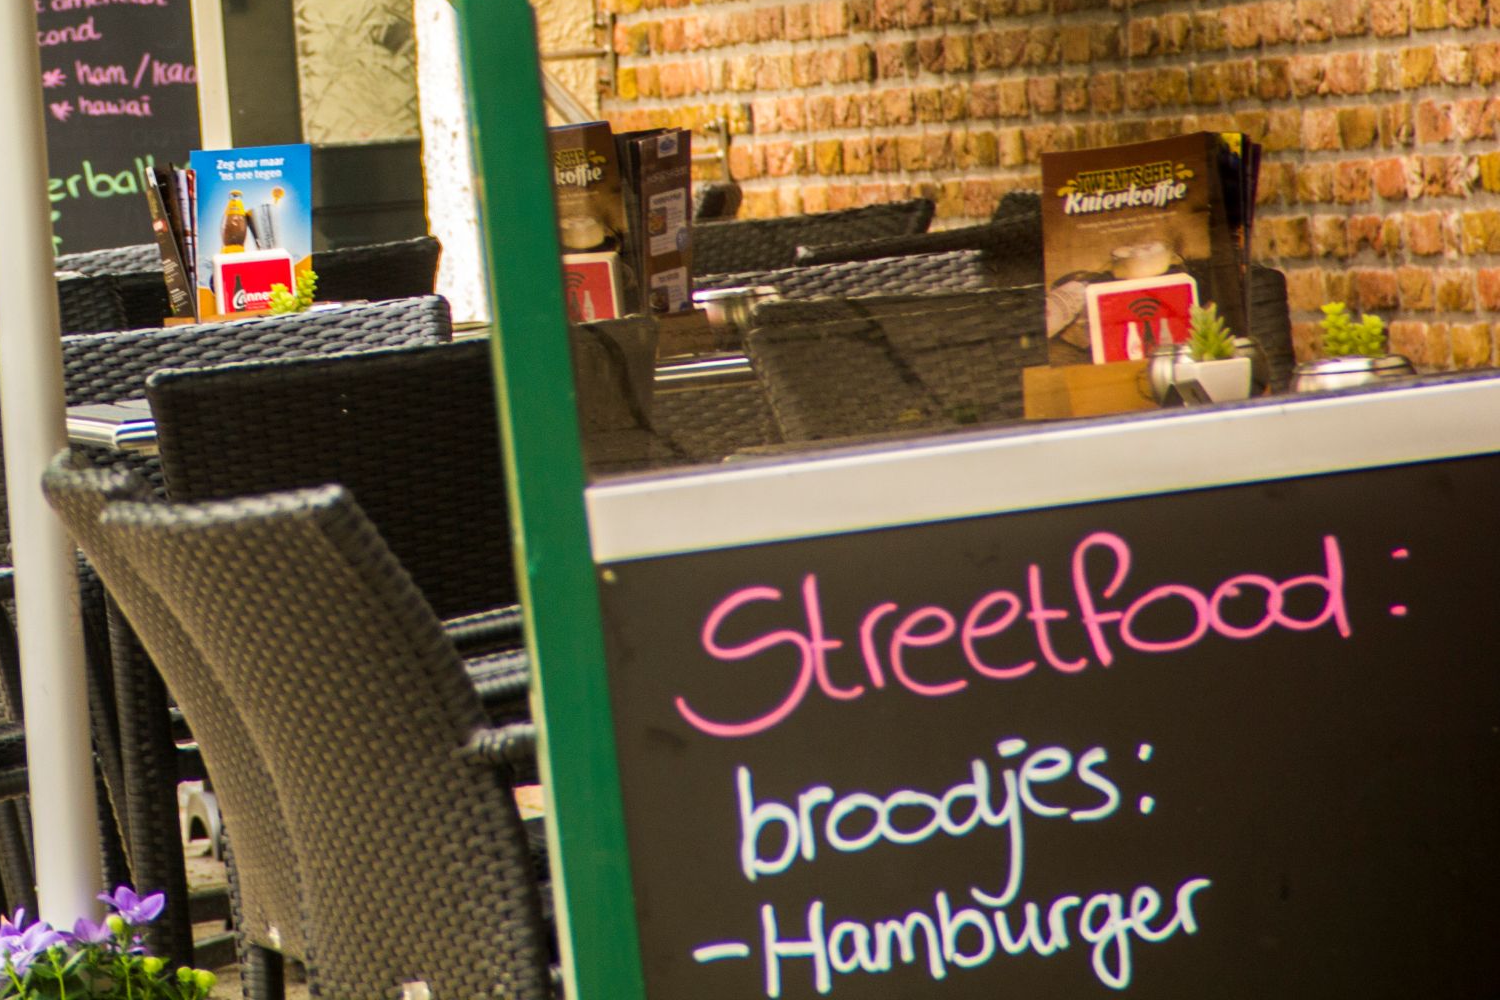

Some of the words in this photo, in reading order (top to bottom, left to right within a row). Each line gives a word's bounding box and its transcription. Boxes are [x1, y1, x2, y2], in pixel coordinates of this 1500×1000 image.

[215, 159, 236, 172] Zeg
[236, 157, 259, 170] daar
[259, 157, 285, 168] maar
[235, 170, 254, 181] nee
[254, 168, 284, 181] tegen
[1076, 160, 1173, 194] TWENTSCHE
